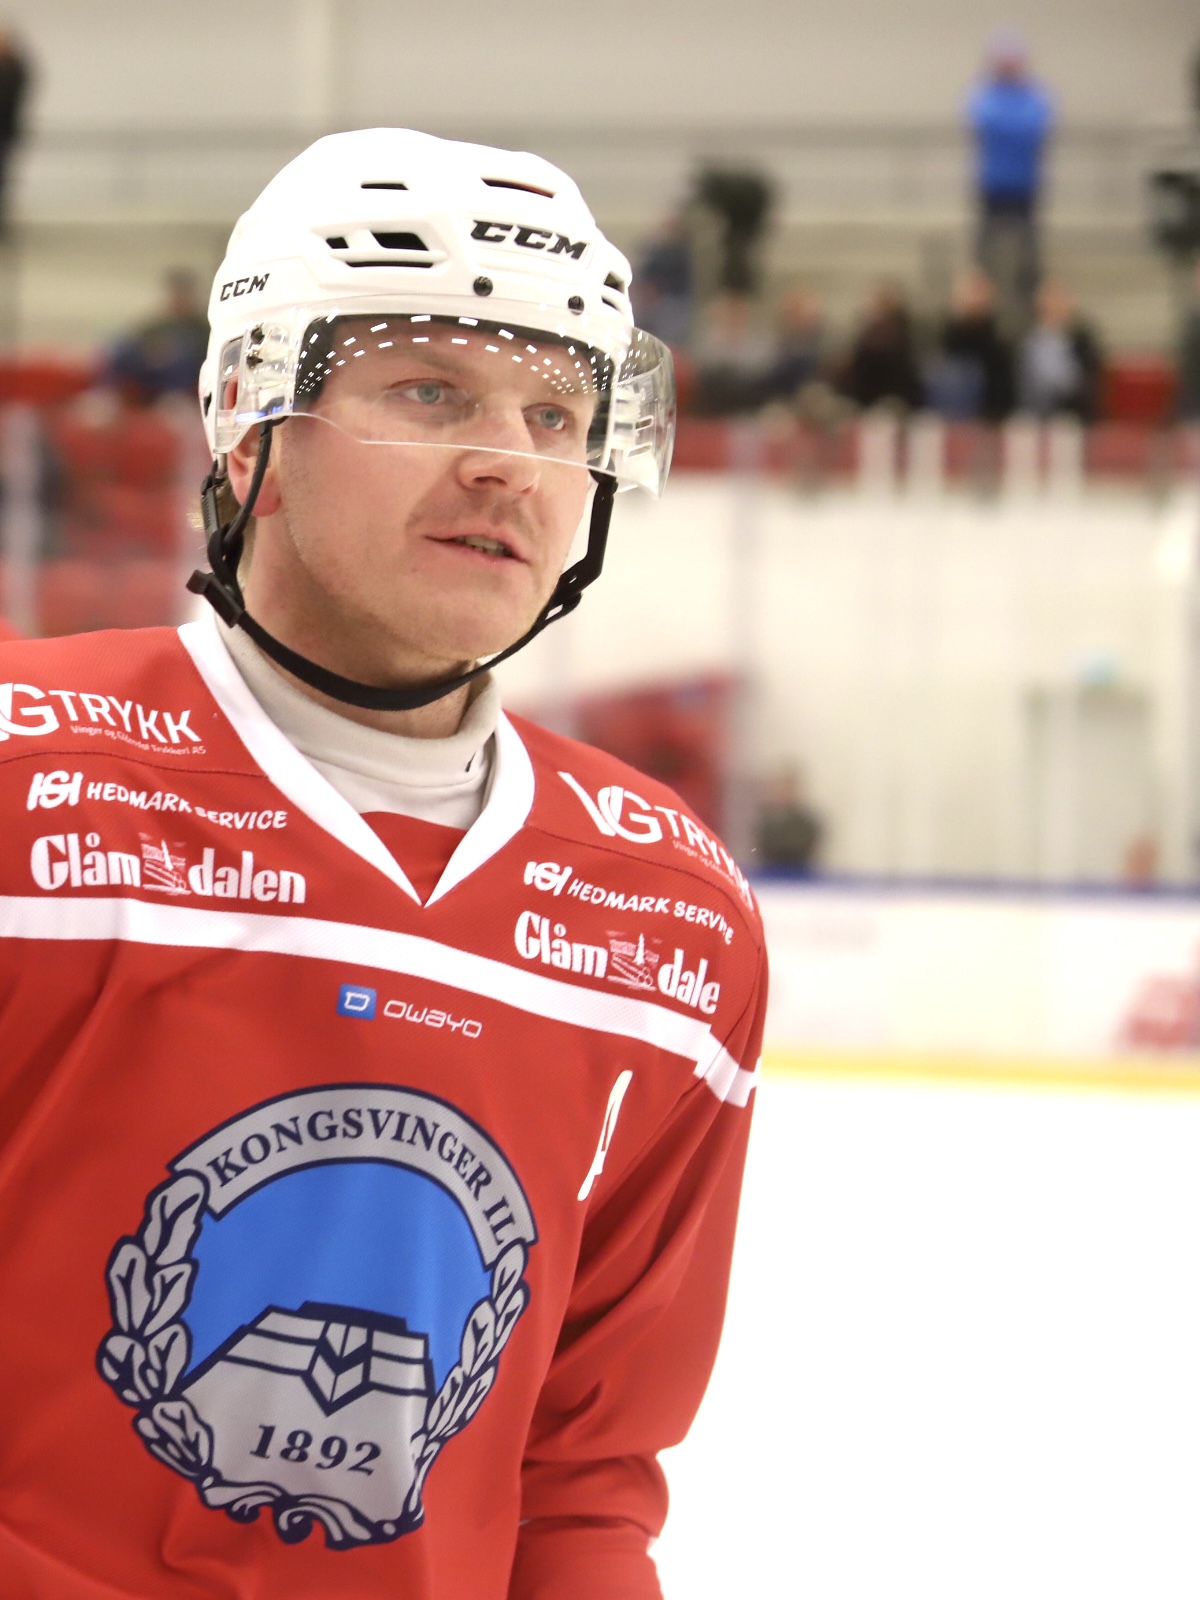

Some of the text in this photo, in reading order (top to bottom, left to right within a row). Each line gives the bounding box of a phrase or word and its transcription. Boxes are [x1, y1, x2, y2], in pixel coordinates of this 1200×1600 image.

[470, 219, 589, 260] CCM
[220, 274, 270, 302] CCM
[48, 689, 202, 744] TRYKK
[86, 781, 192, 814] HEDMARK
[194, 806, 288, 830] SERVICE
[567, 878, 670, 914] HEDMARK
[207, 1107, 516, 1246] KONGSVINGER IL
[249, 1424, 383, 1476] 1892
